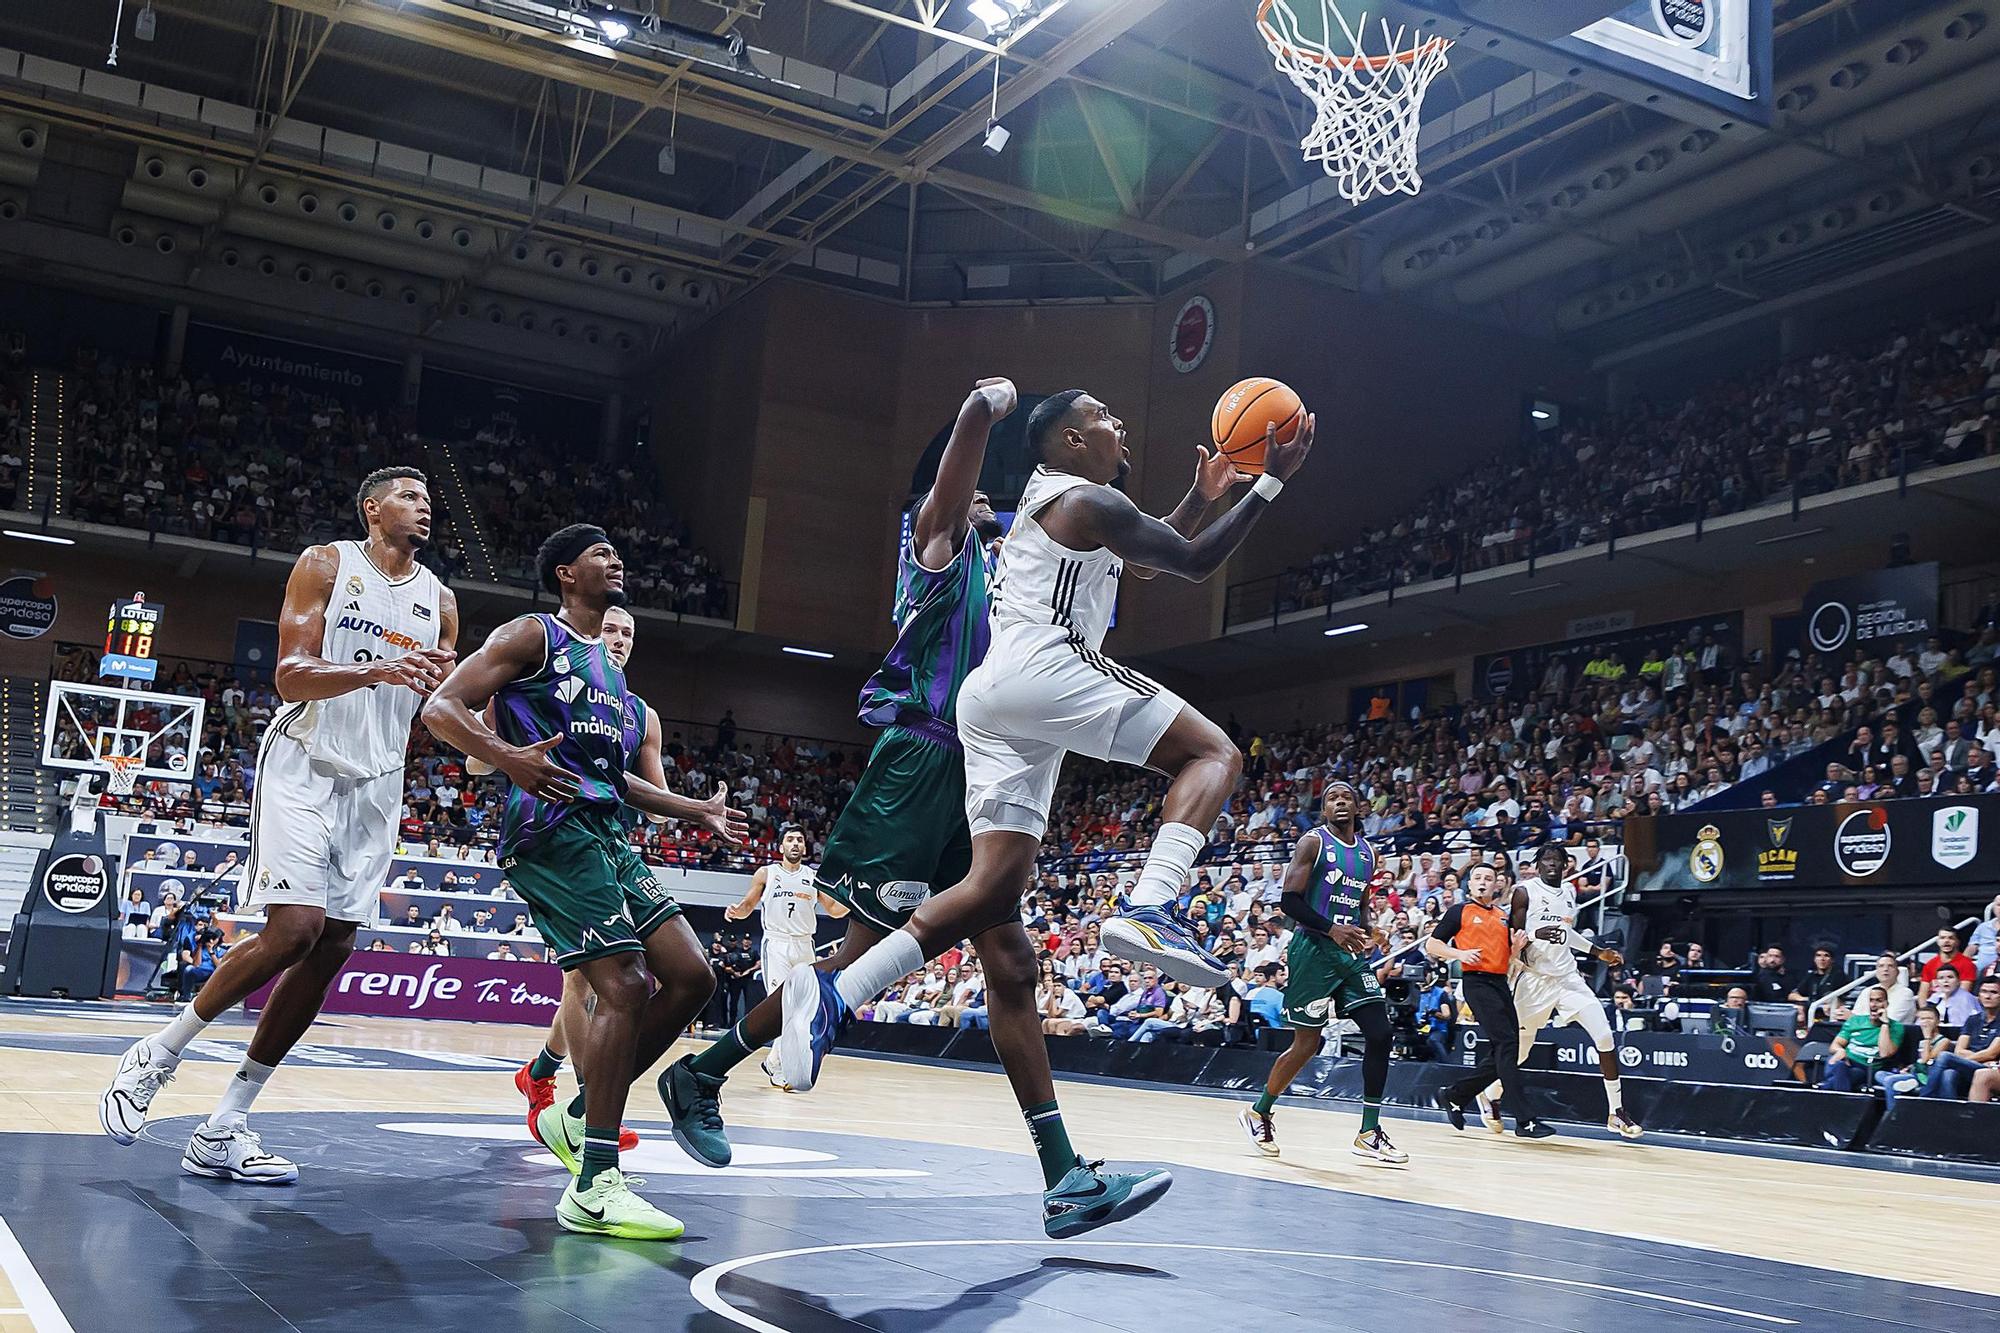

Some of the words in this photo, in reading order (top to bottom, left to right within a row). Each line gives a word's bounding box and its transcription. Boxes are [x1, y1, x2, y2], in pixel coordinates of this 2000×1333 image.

[220, 345, 363, 386] Ayuntamiento
[0, 597, 53, 612] upercopa
[0, 606, 51, 622] endesa
[121, 608, 158, 622] LOTUS
[1857, 625, 1874, 640] DE
[1876, 618, 1929, 638] MURCIA
[124, 634, 152, 659] 18
[1842, 842, 1885, 855] endesa
[1758, 849, 1798, 865] UCAM
[51, 873, 101, 885] supercopa
[459, 874, 478, 885] acb
[54, 882, 100, 895] endesa
[787, 903, 796, 919] 7
[338, 963, 463, 1010] renfe
[474, 977, 507, 1004] Tu
[1744, 1051, 1779, 1070] acb
